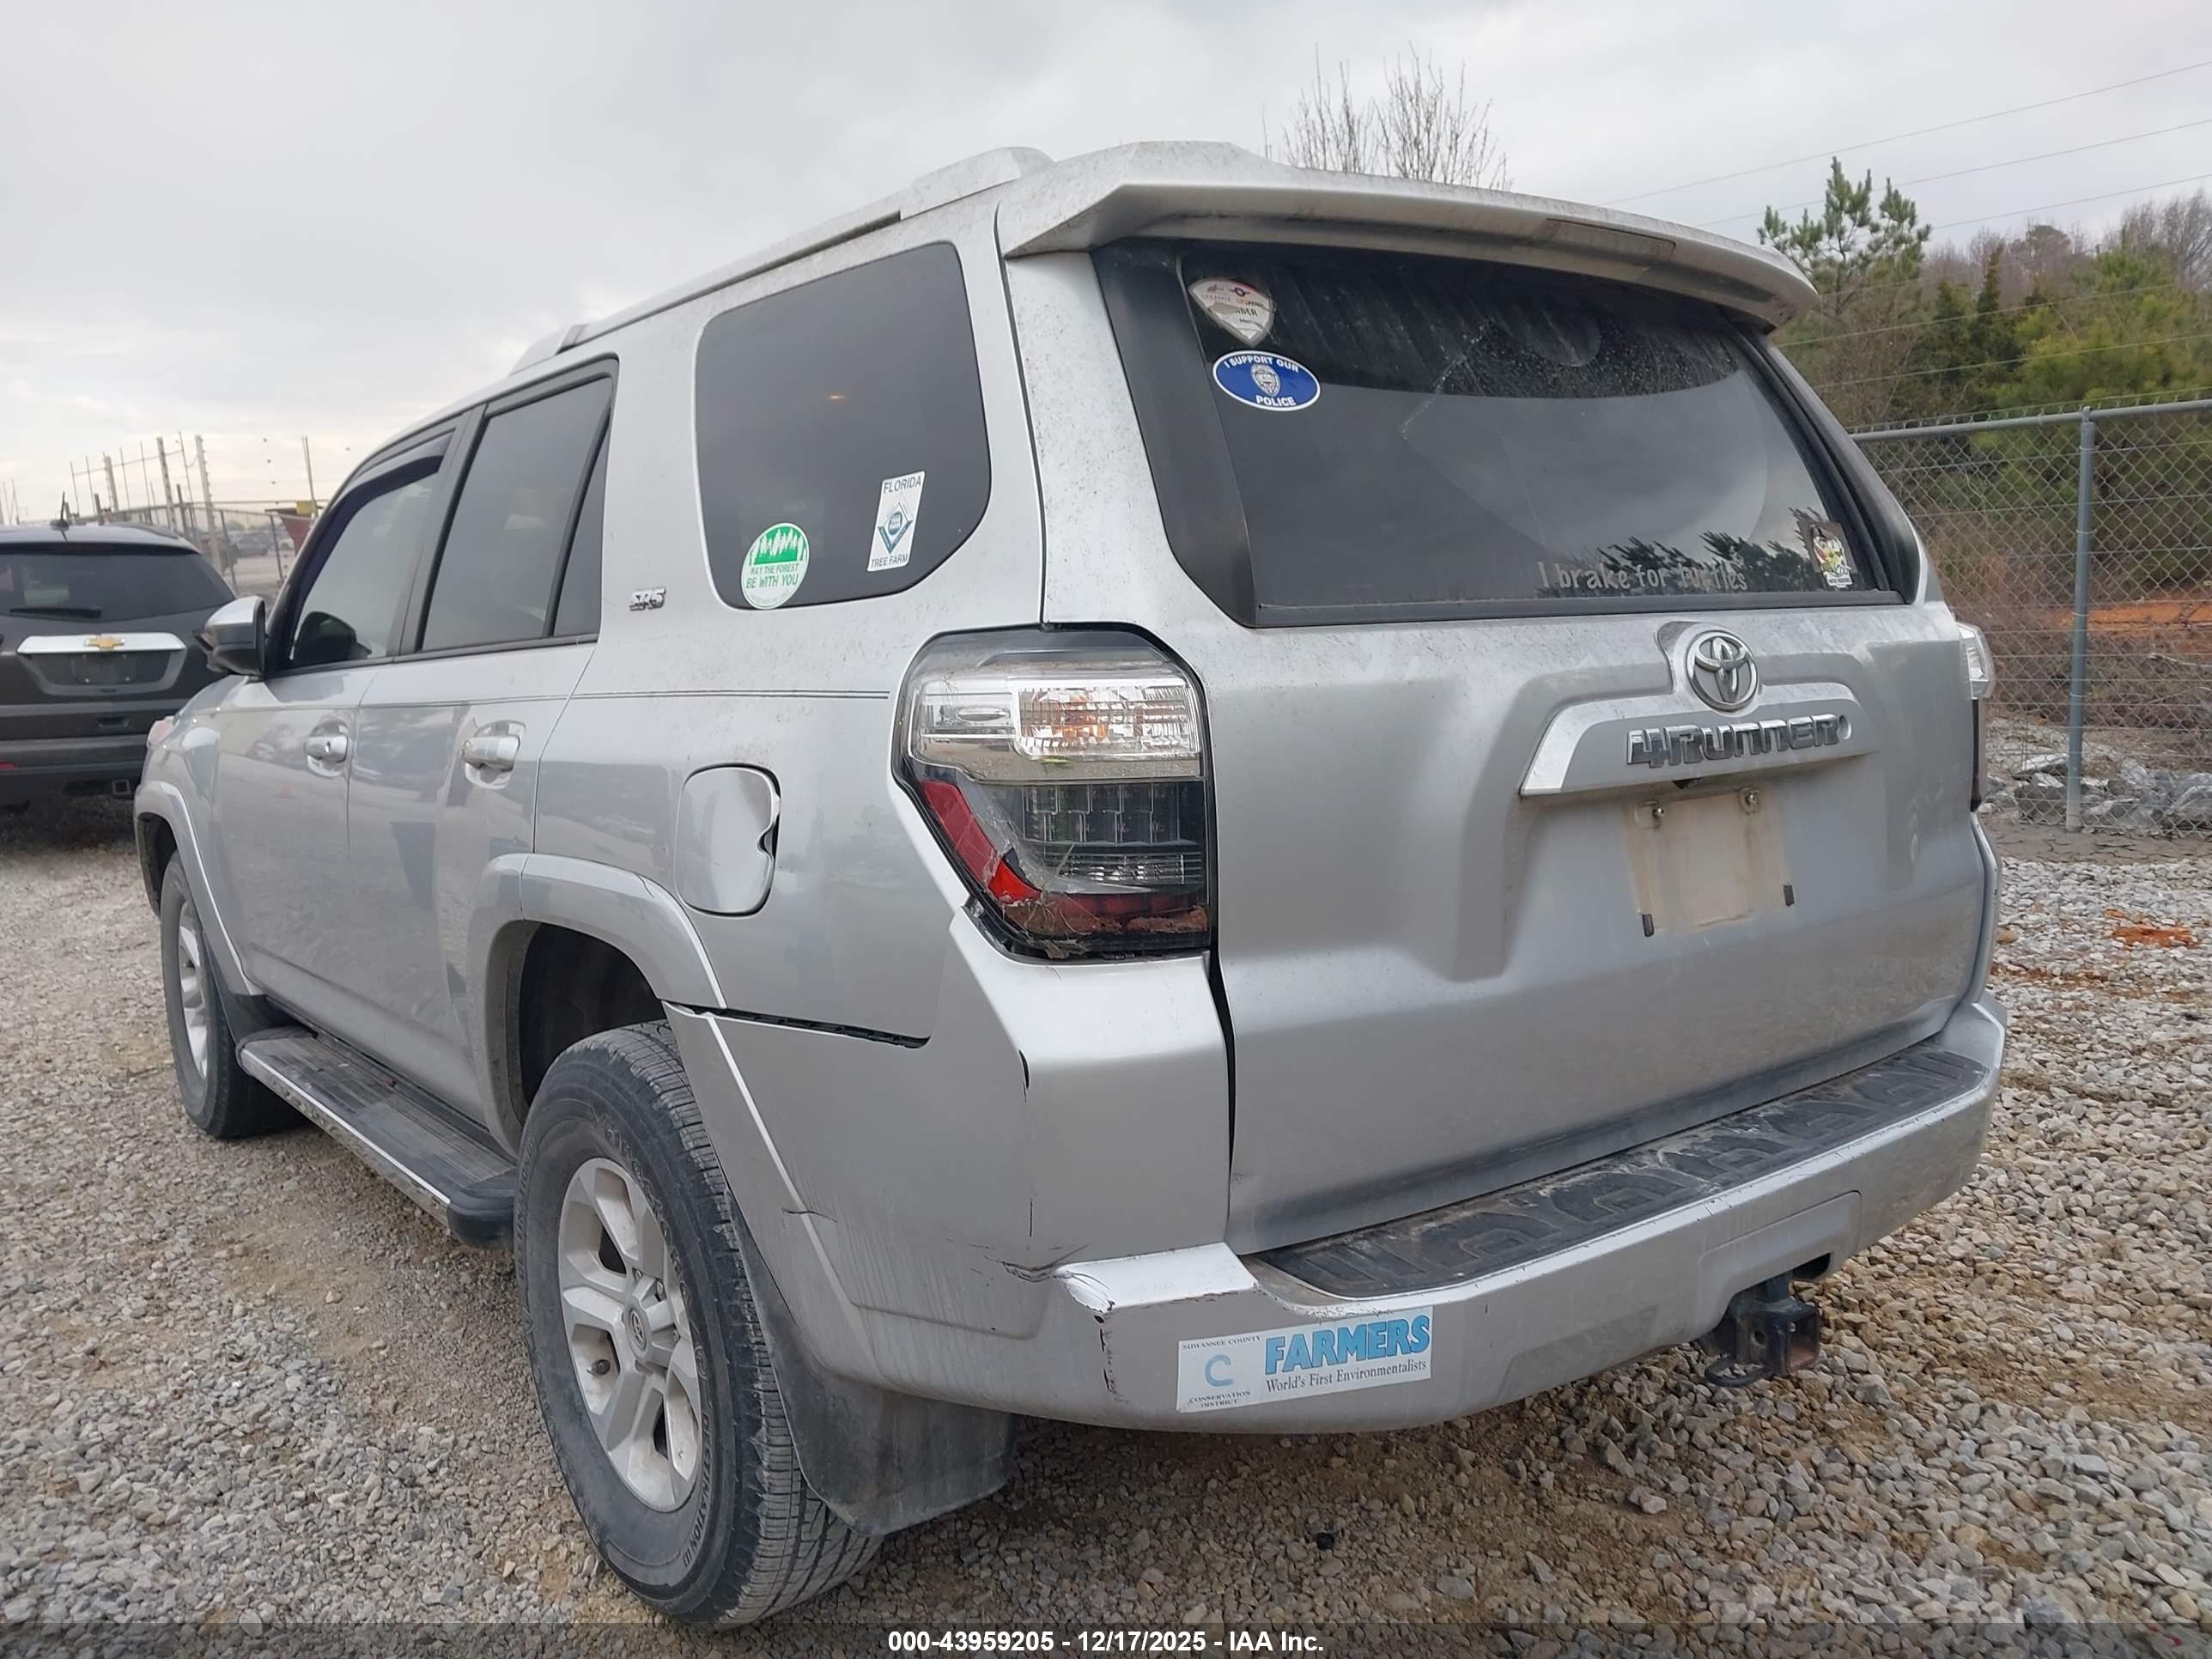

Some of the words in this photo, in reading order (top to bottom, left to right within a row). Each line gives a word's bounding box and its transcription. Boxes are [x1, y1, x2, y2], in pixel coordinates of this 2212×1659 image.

[1224, 361, 1231, 369] I
[1231, 356, 1273, 366] SUPPORT
[1276, 359, 1299, 374] OUR
[1255, 394, 1297, 407] POLICE
[883, 474, 922, 495] FLORIDA
[763, 564, 775, 574] THE
[775, 562, 799, 573] FOREST
[871, 556, 889, 568] TREE
[889, 553, 908, 565] FARM
[746, 577, 757, 589] BE
[759, 575, 779, 588] WITH
[781, 574, 799, 586] YOU
[1538, 562, 1550, 589] I
[1554, 562, 1631, 590] brake
[1634, 563, 1670, 587] for
[629, 586, 666, 612] SR5
[1228, 1334, 1261, 1346] COUNTY
[1264, 1315, 1431, 1376] FARMERS
[1265, 1374, 1307, 1394] World's
[1310, 1372, 1334, 1386] First
[1335, 1359, 1428, 1382] Environmentalists
[1188, 1389, 1252, 1404] CONSERVATION
[1200, 1399, 1239, 1409] DISTRICT
